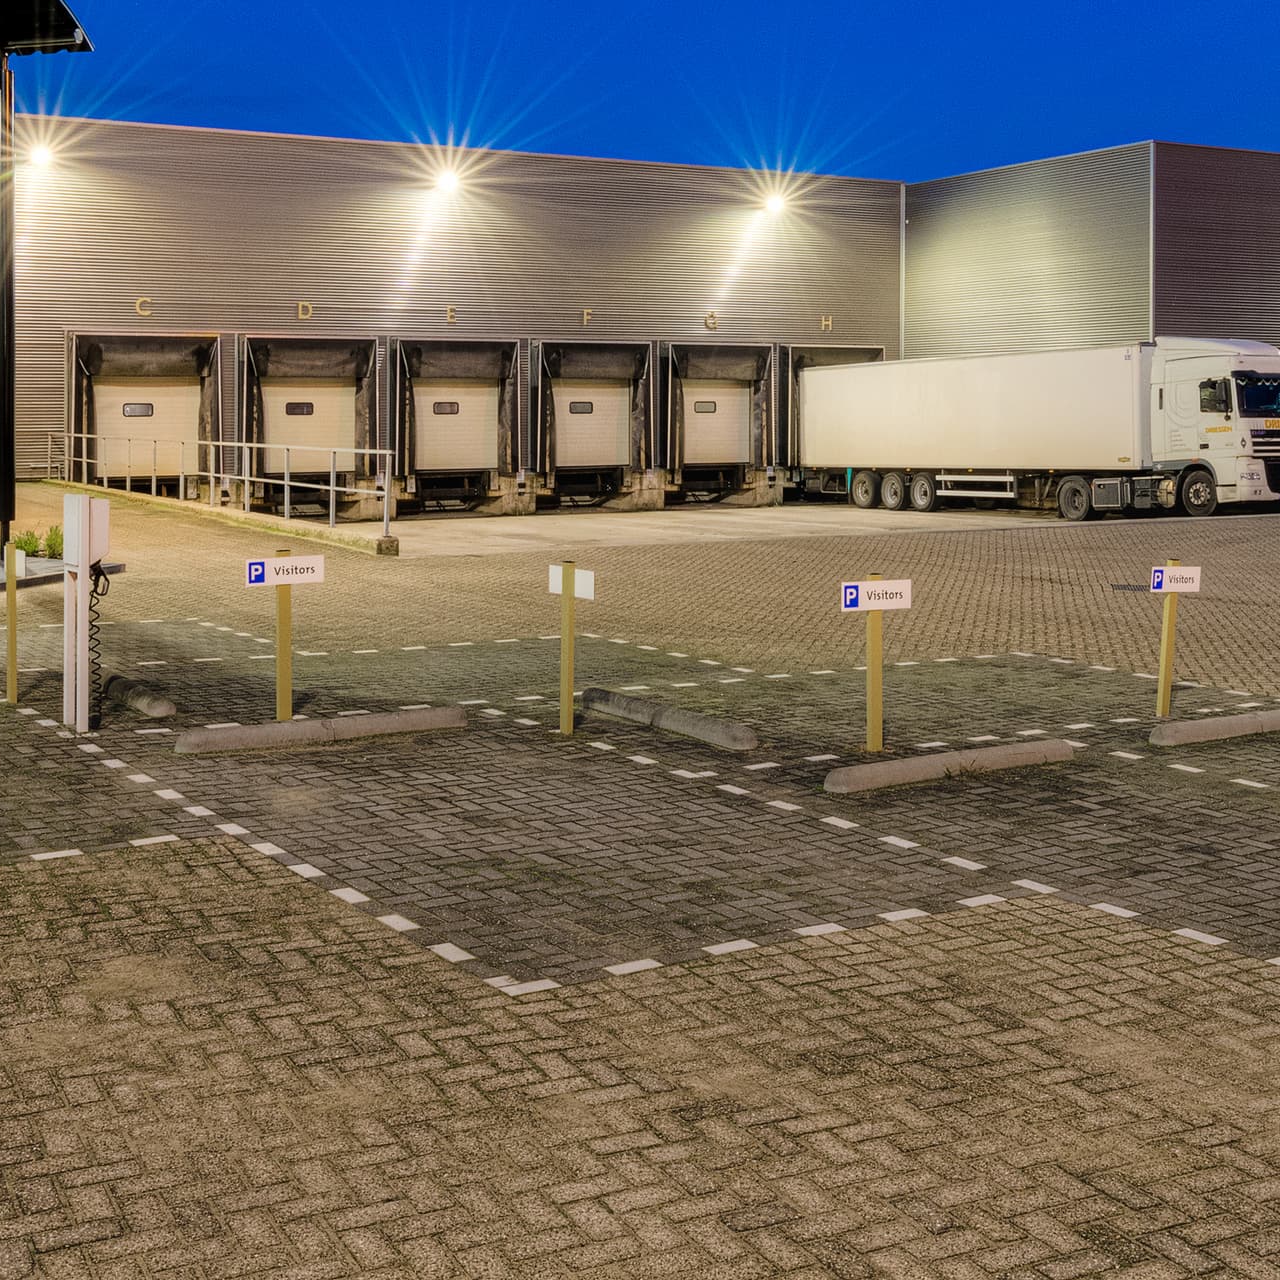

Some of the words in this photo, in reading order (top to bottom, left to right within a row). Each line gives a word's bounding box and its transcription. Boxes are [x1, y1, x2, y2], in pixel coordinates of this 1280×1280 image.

[135, 297, 153, 316] C
[297, 301, 313, 320] D
[447, 305, 457, 324] E
[583, 308, 593, 326] F
[704, 311, 719, 331] G
[821, 315, 833, 331] H
[250, 564, 263, 581] P
[273, 565, 316, 576] Visitors
[1154, 572, 1163, 587] P
[1168, 575, 1195, 584] Visitors
[846, 588, 857, 605] P
[866, 589, 904, 600] Visitors
